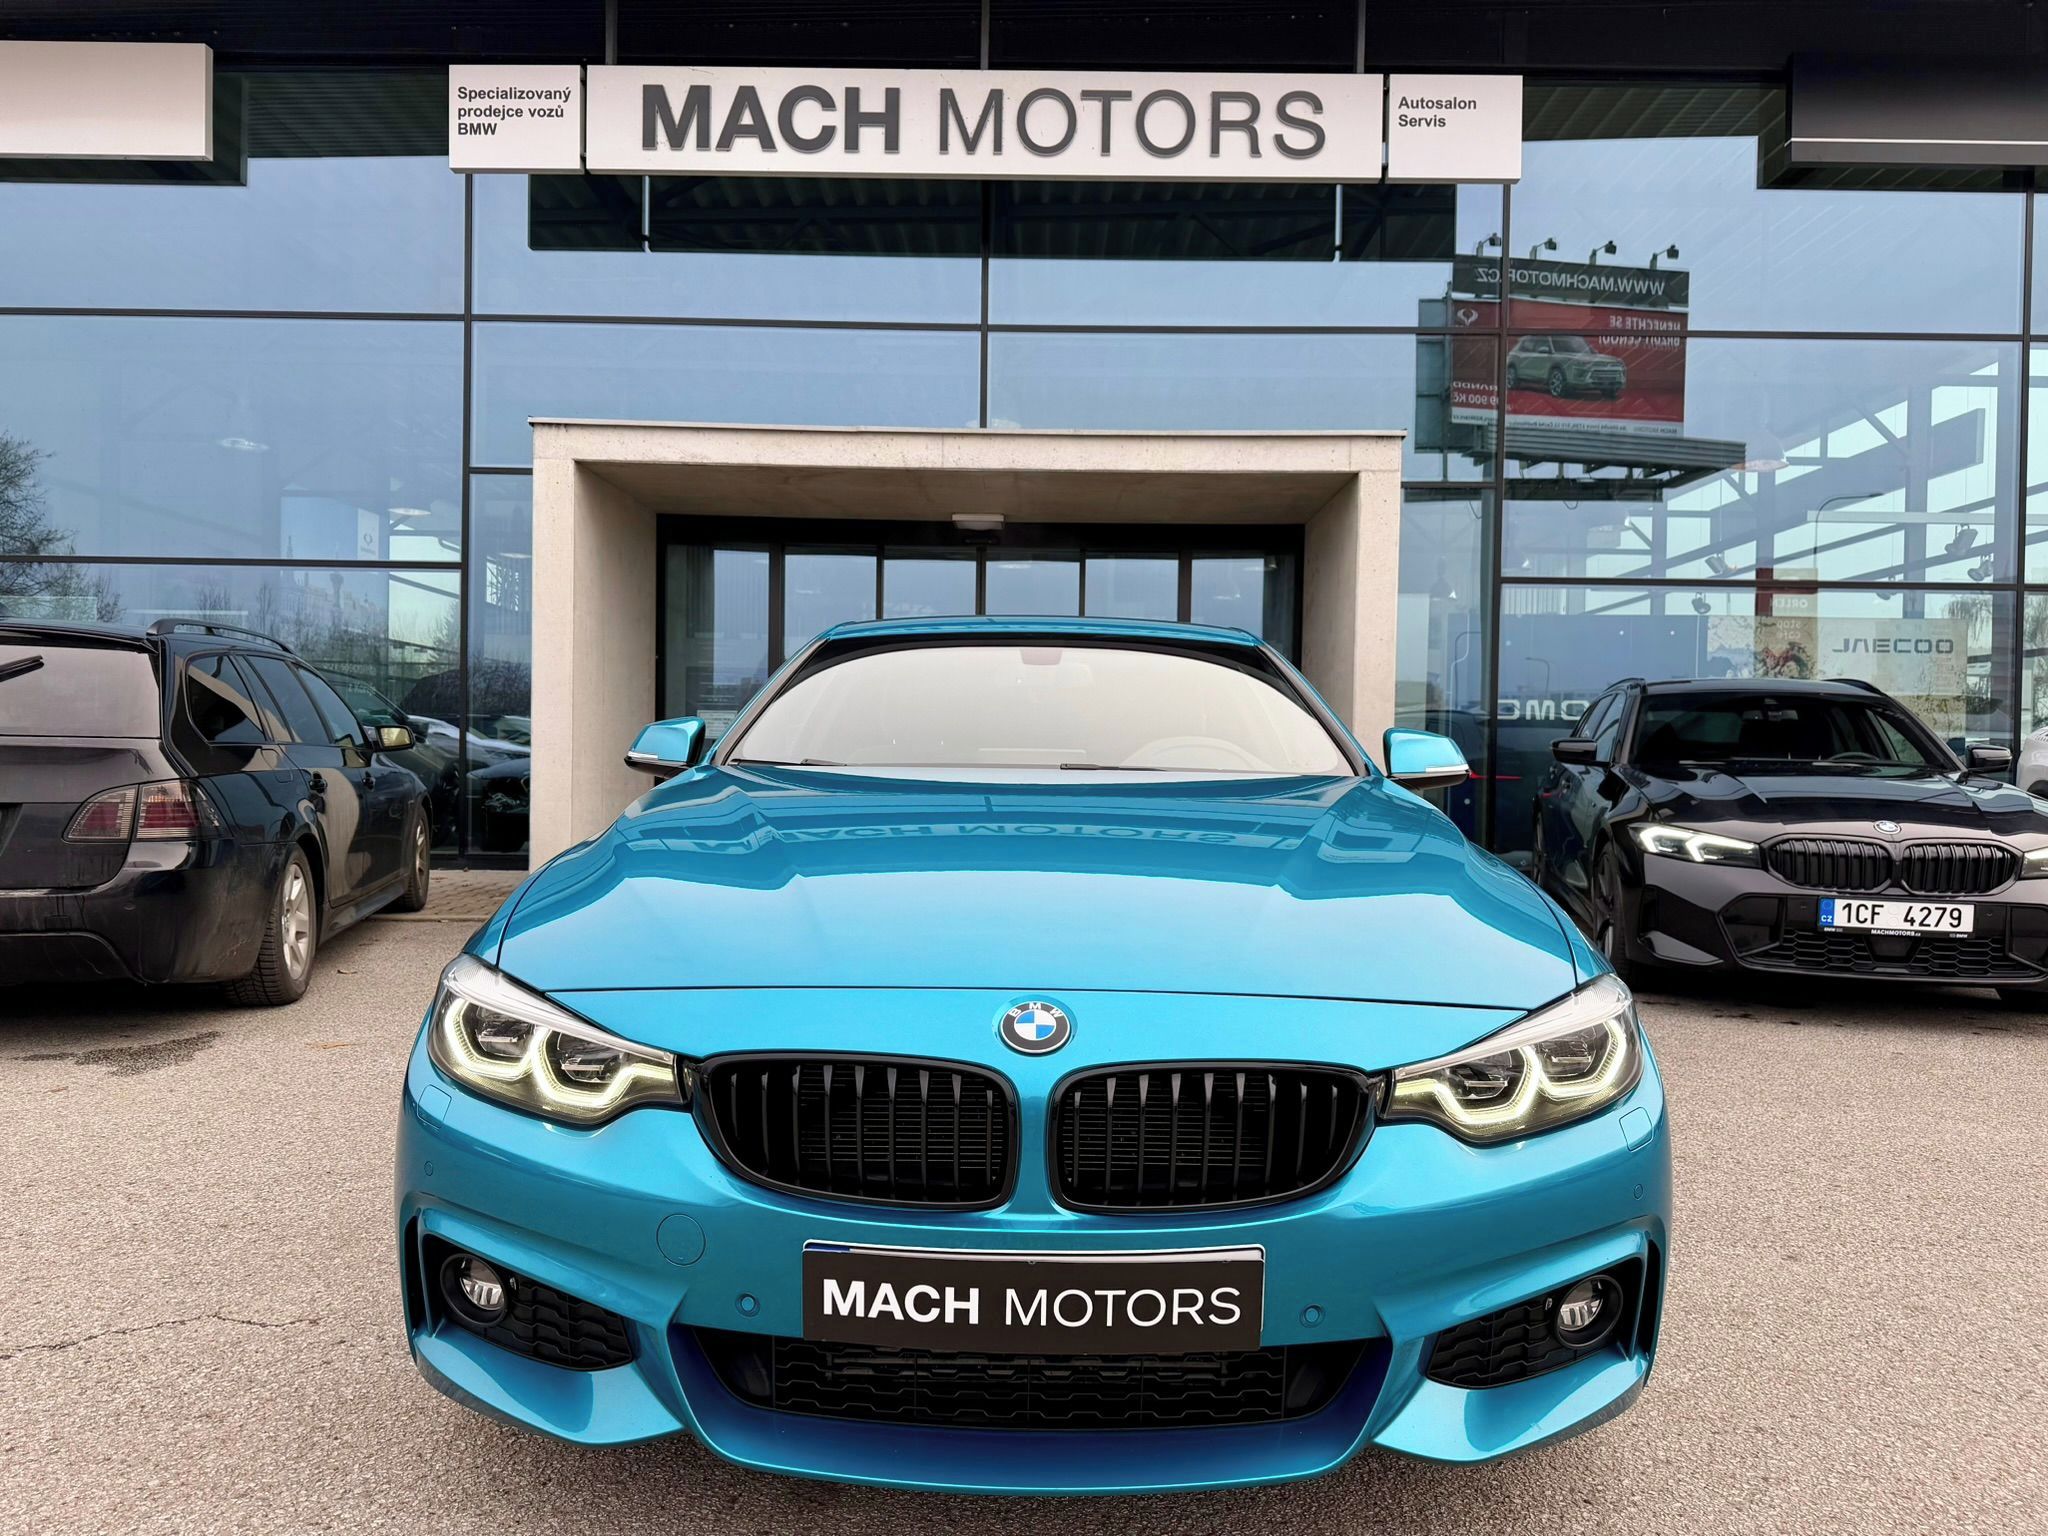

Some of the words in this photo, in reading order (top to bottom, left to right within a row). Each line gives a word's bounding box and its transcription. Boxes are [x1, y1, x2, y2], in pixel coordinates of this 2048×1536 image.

[457, 86, 571, 102] Specializovaný
[1397, 95, 1477, 110] Autosalon
[457, 104, 525, 121] prodejce
[527, 103, 564, 119] vozů
[457, 122, 497, 136] BMW
[641, 83, 901, 154] MACH
[939, 87, 1326, 159] MOTORS
[1397, 114, 1447, 128] Servis
[1820, 914, 1834, 923] CZ
[1841, 903, 1885, 926] 1CF
[1903, 905, 1963, 928] 4279
[1007, 1001, 1065, 1018] BMW
[822, 1278, 980, 1325] MACH
[1005, 1286, 1242, 1328] MOTORS
